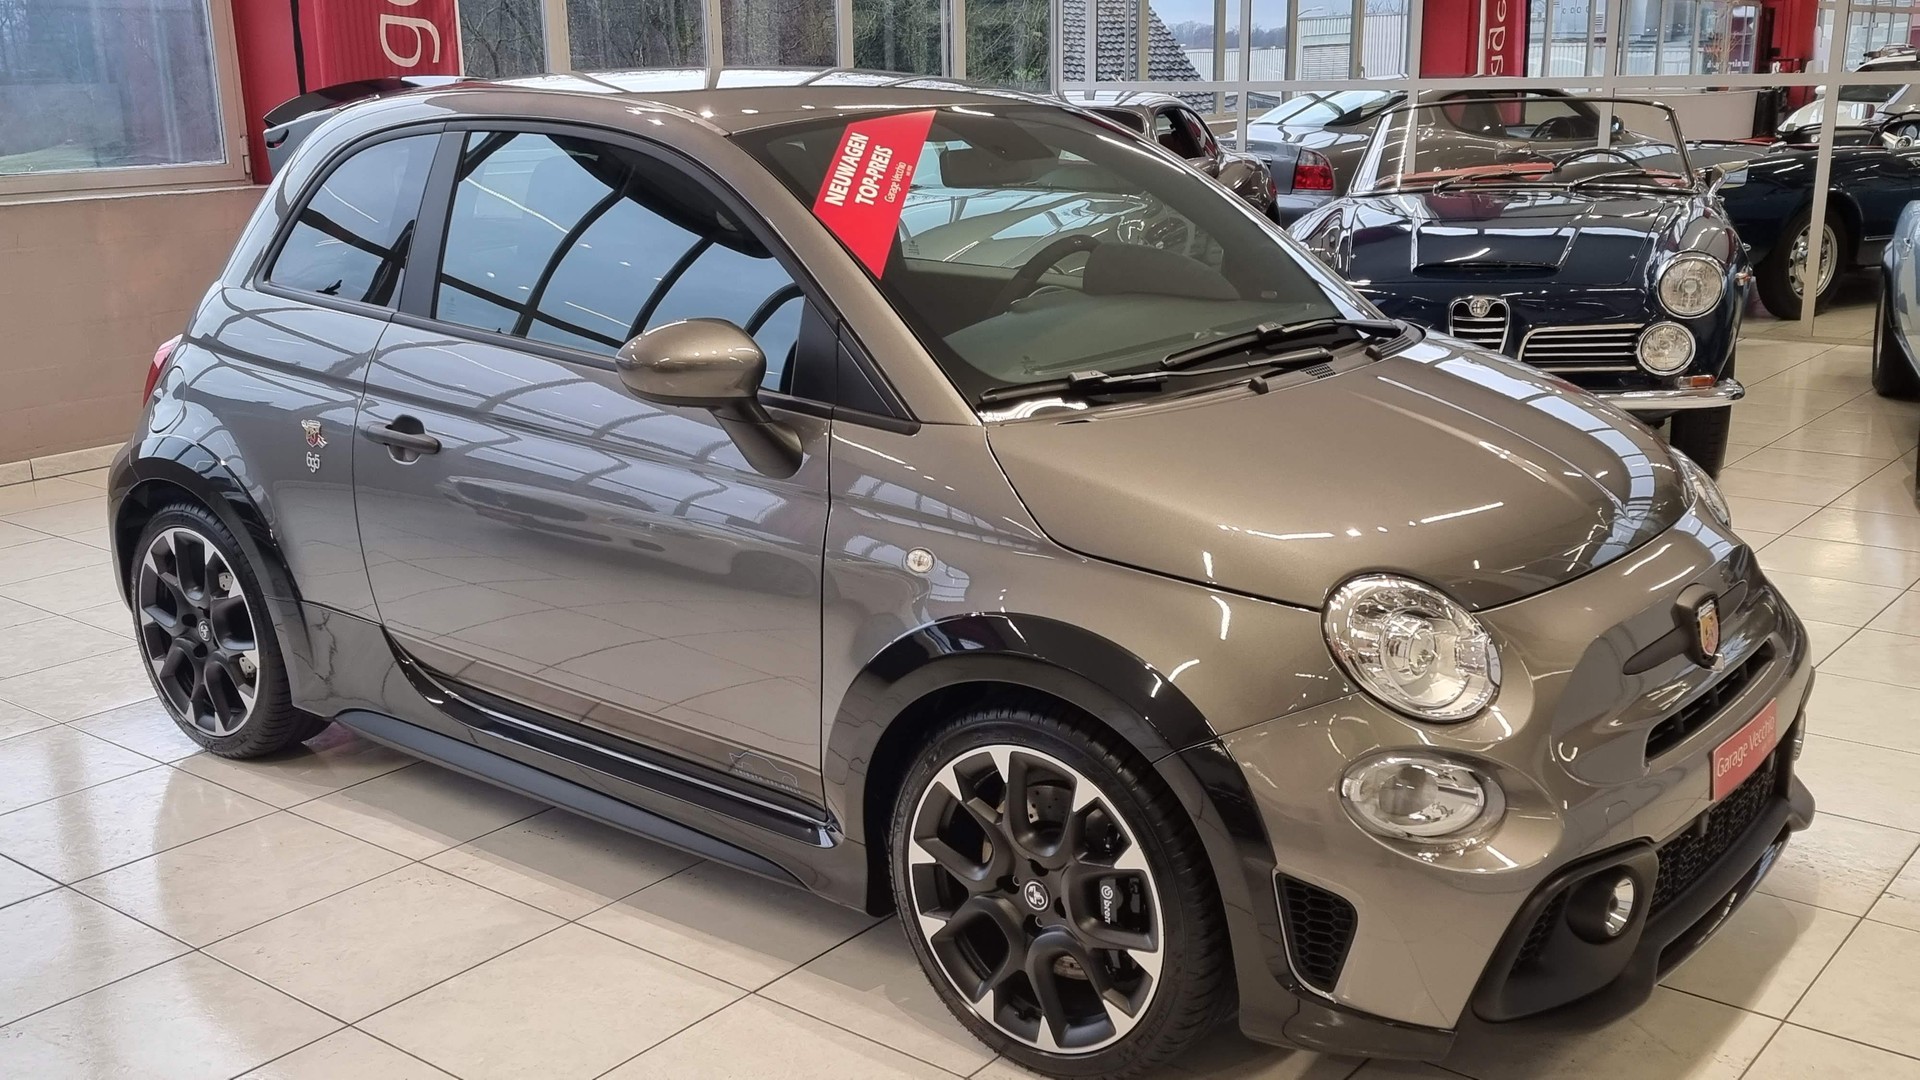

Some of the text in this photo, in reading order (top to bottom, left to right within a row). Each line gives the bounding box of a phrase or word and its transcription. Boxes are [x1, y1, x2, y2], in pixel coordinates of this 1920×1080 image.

[824, 132, 869, 206] NEUWAGEN
[855, 145, 893, 205] TOP-PREIS
[884, 161, 907, 203] Garage Vecchio
[306, 451, 320, 473] 695
[1717, 742, 1748, 777] Garage
[1749, 715, 1775, 751] Vecchio
